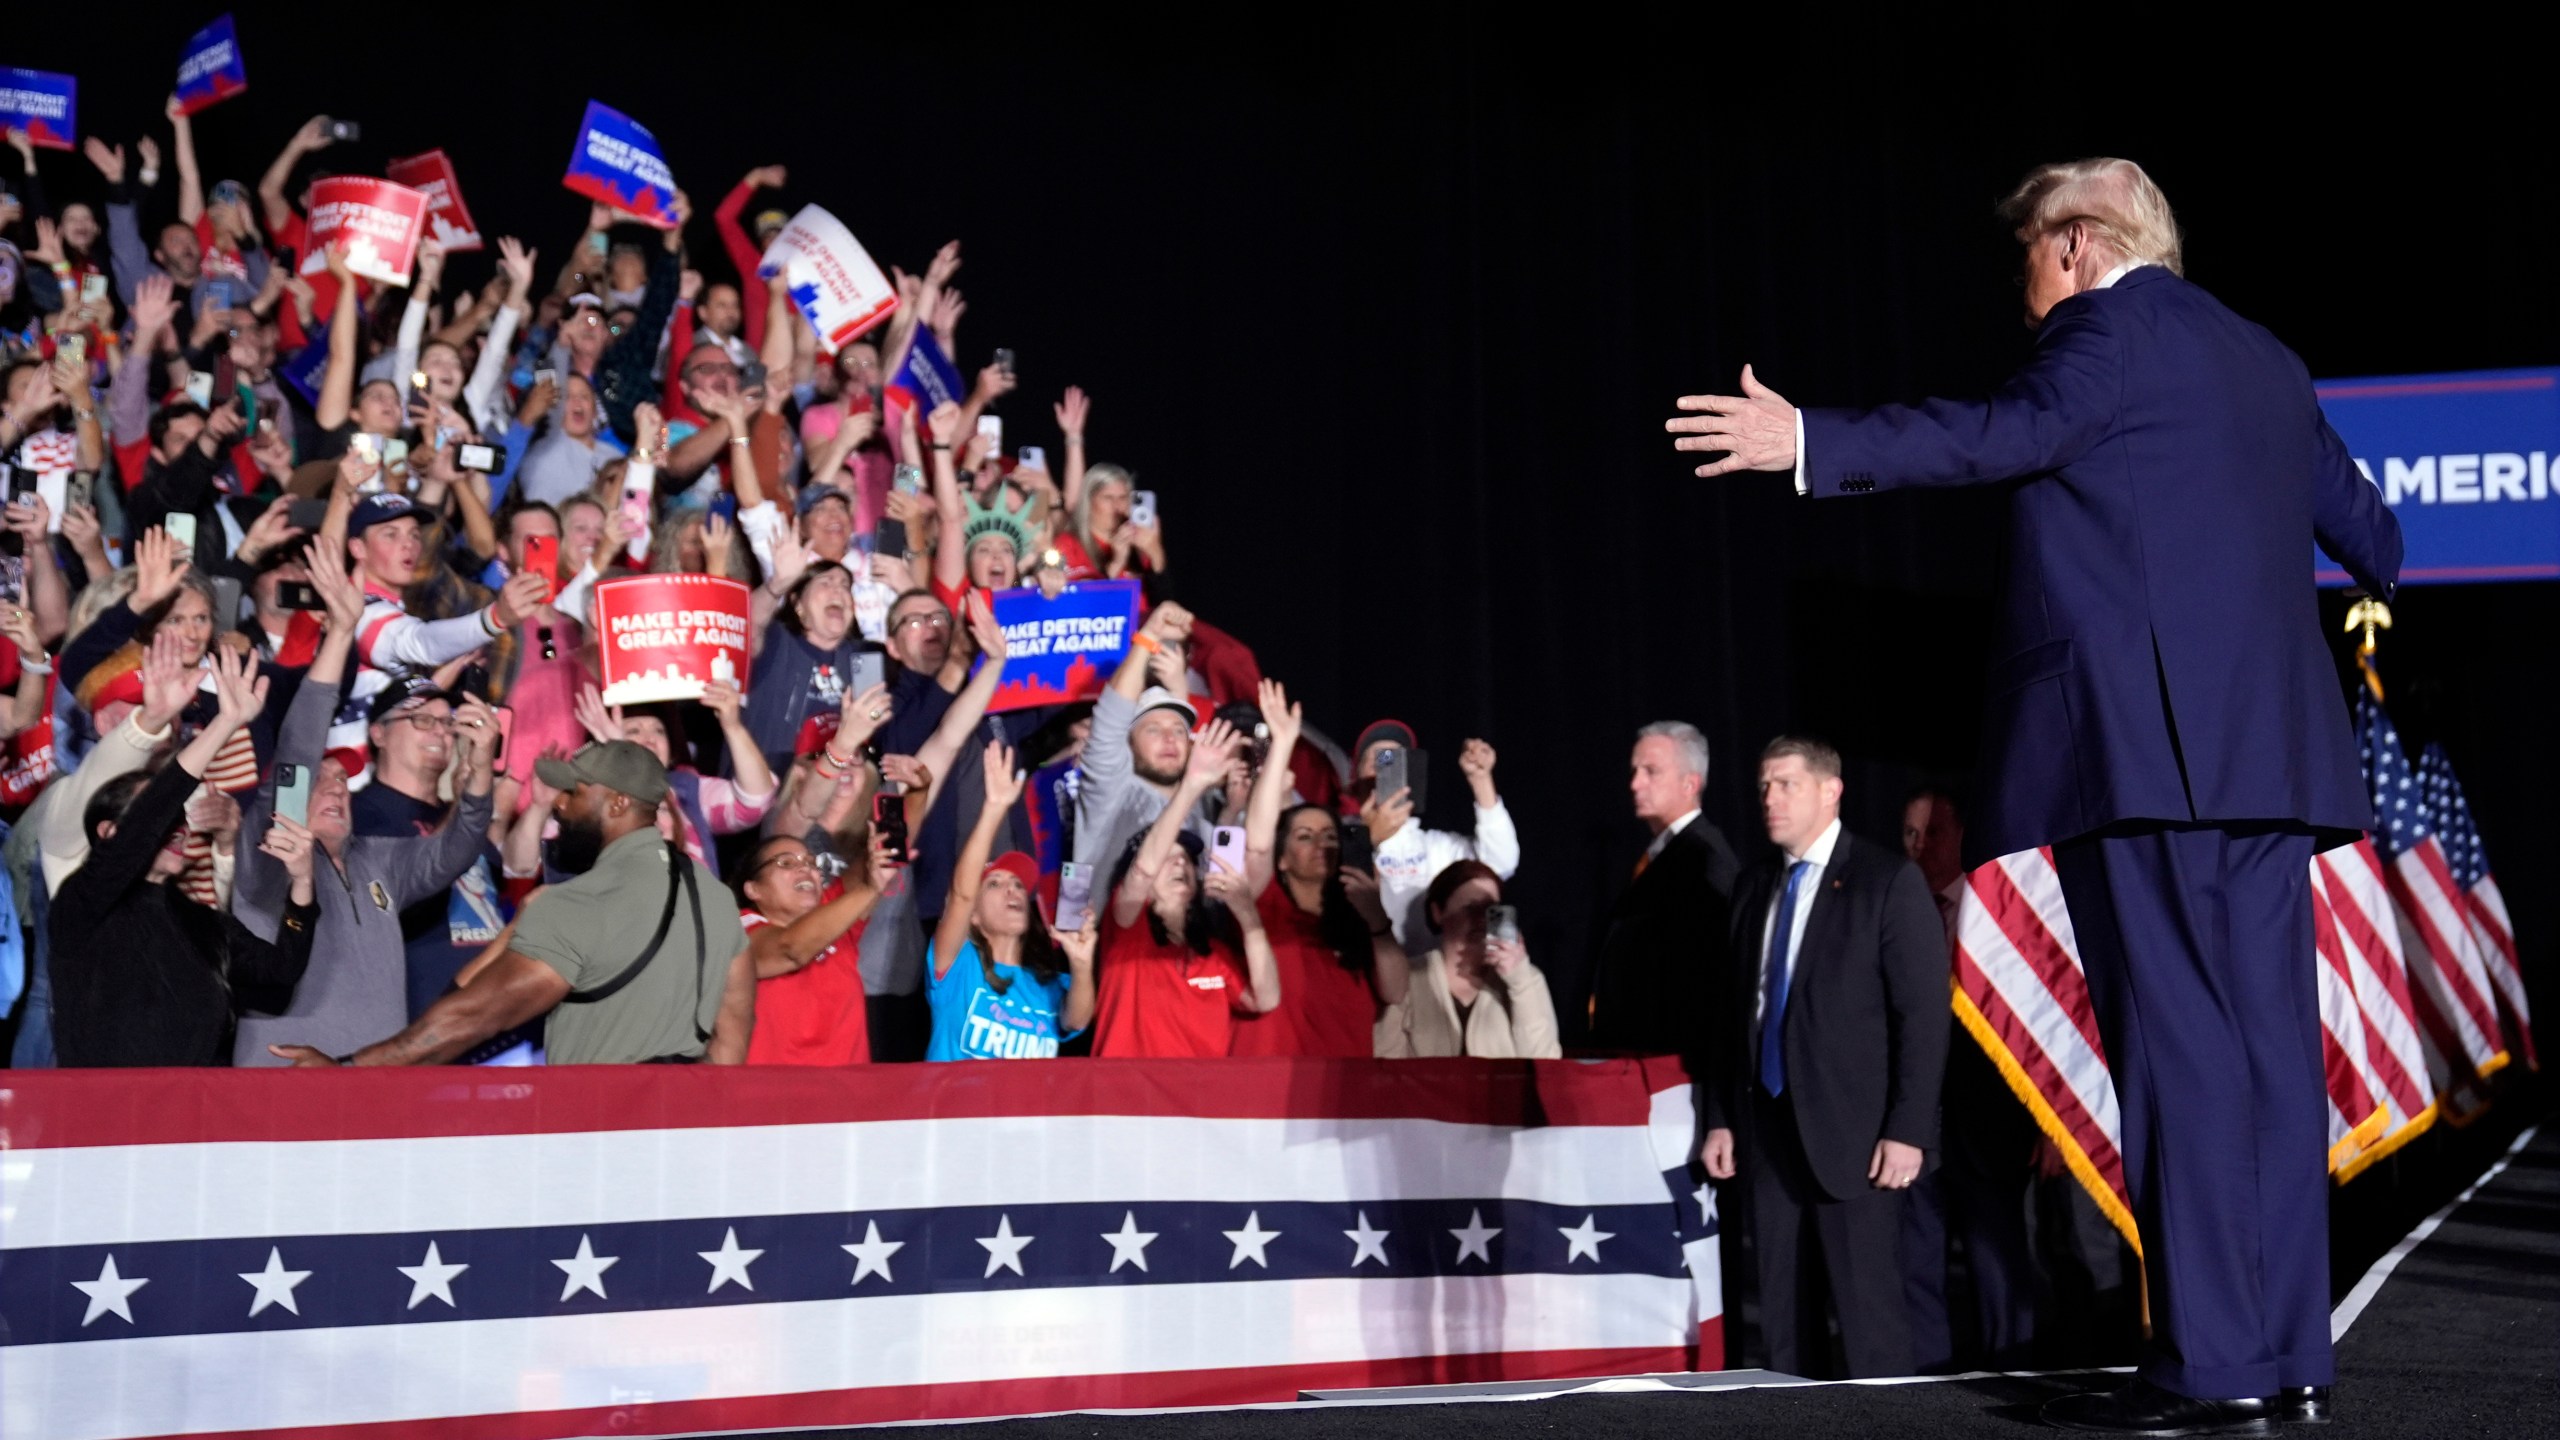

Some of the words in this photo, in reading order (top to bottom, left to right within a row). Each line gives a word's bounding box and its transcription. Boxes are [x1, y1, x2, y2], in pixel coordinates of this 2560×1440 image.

[340, 201, 411, 230] DETROIT
[819, 244, 862, 299] DETROIT
[2352, 451, 2560, 505] MERI
[611, 611, 674, 634] MAKE
[677, 610, 747, 633] DETROIT
[1042, 616, 1127, 637] DETROIT
[616, 628, 690, 651] GREAT
[693, 627, 746, 651] AGAIN!
[1005, 636, 1051, 659] REAT
[1052, 633, 1121, 654] AGAIN!
[968, 1014, 1060, 1060] TRUMP
